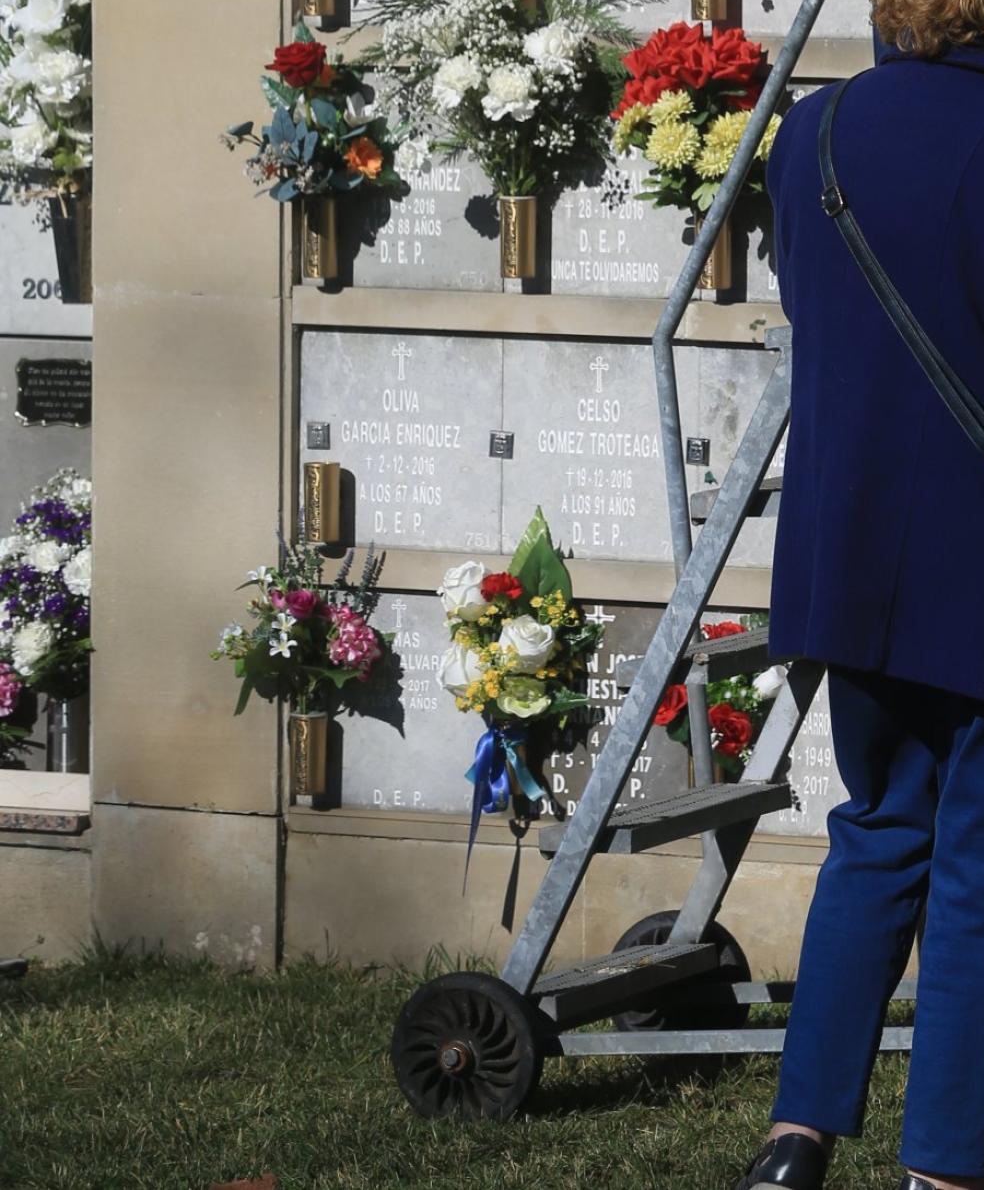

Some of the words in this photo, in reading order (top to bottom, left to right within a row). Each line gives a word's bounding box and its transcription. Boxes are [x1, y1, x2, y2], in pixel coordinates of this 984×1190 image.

[414, 215, 441, 236] AÑOS
[593, 262, 659, 283] OLVIDAREMOS
[382, 389, 420, 413] OLIVA
[577, 398, 621, 423] CELSO
[341, 420, 391, 445] GARCIA
[396, 423, 461, 449] ENRIQUEZ
[538, 429, 584, 455] GOMEZ
[590, 431, 660, 458] TROTEAGA
[392, 456, 403, 474] 12
[411, 458, 435, 475] 2016
[576, 468, 586, 487] 19
[594, 469, 603, 488] 12
[610, 470, 633, 490] 2016
[370, 484, 391, 503] LOS
[413, 481, 442, 505] AÑOS
[571, 495, 591, 514] LOS
[608, 492, 636, 517] AÑOS
[408, 679, 430, 692] 2017
[409, 693, 438, 710] AÑOS
[804, 746, 832, 767] 1949
[803, 776, 829, 795] 2017
